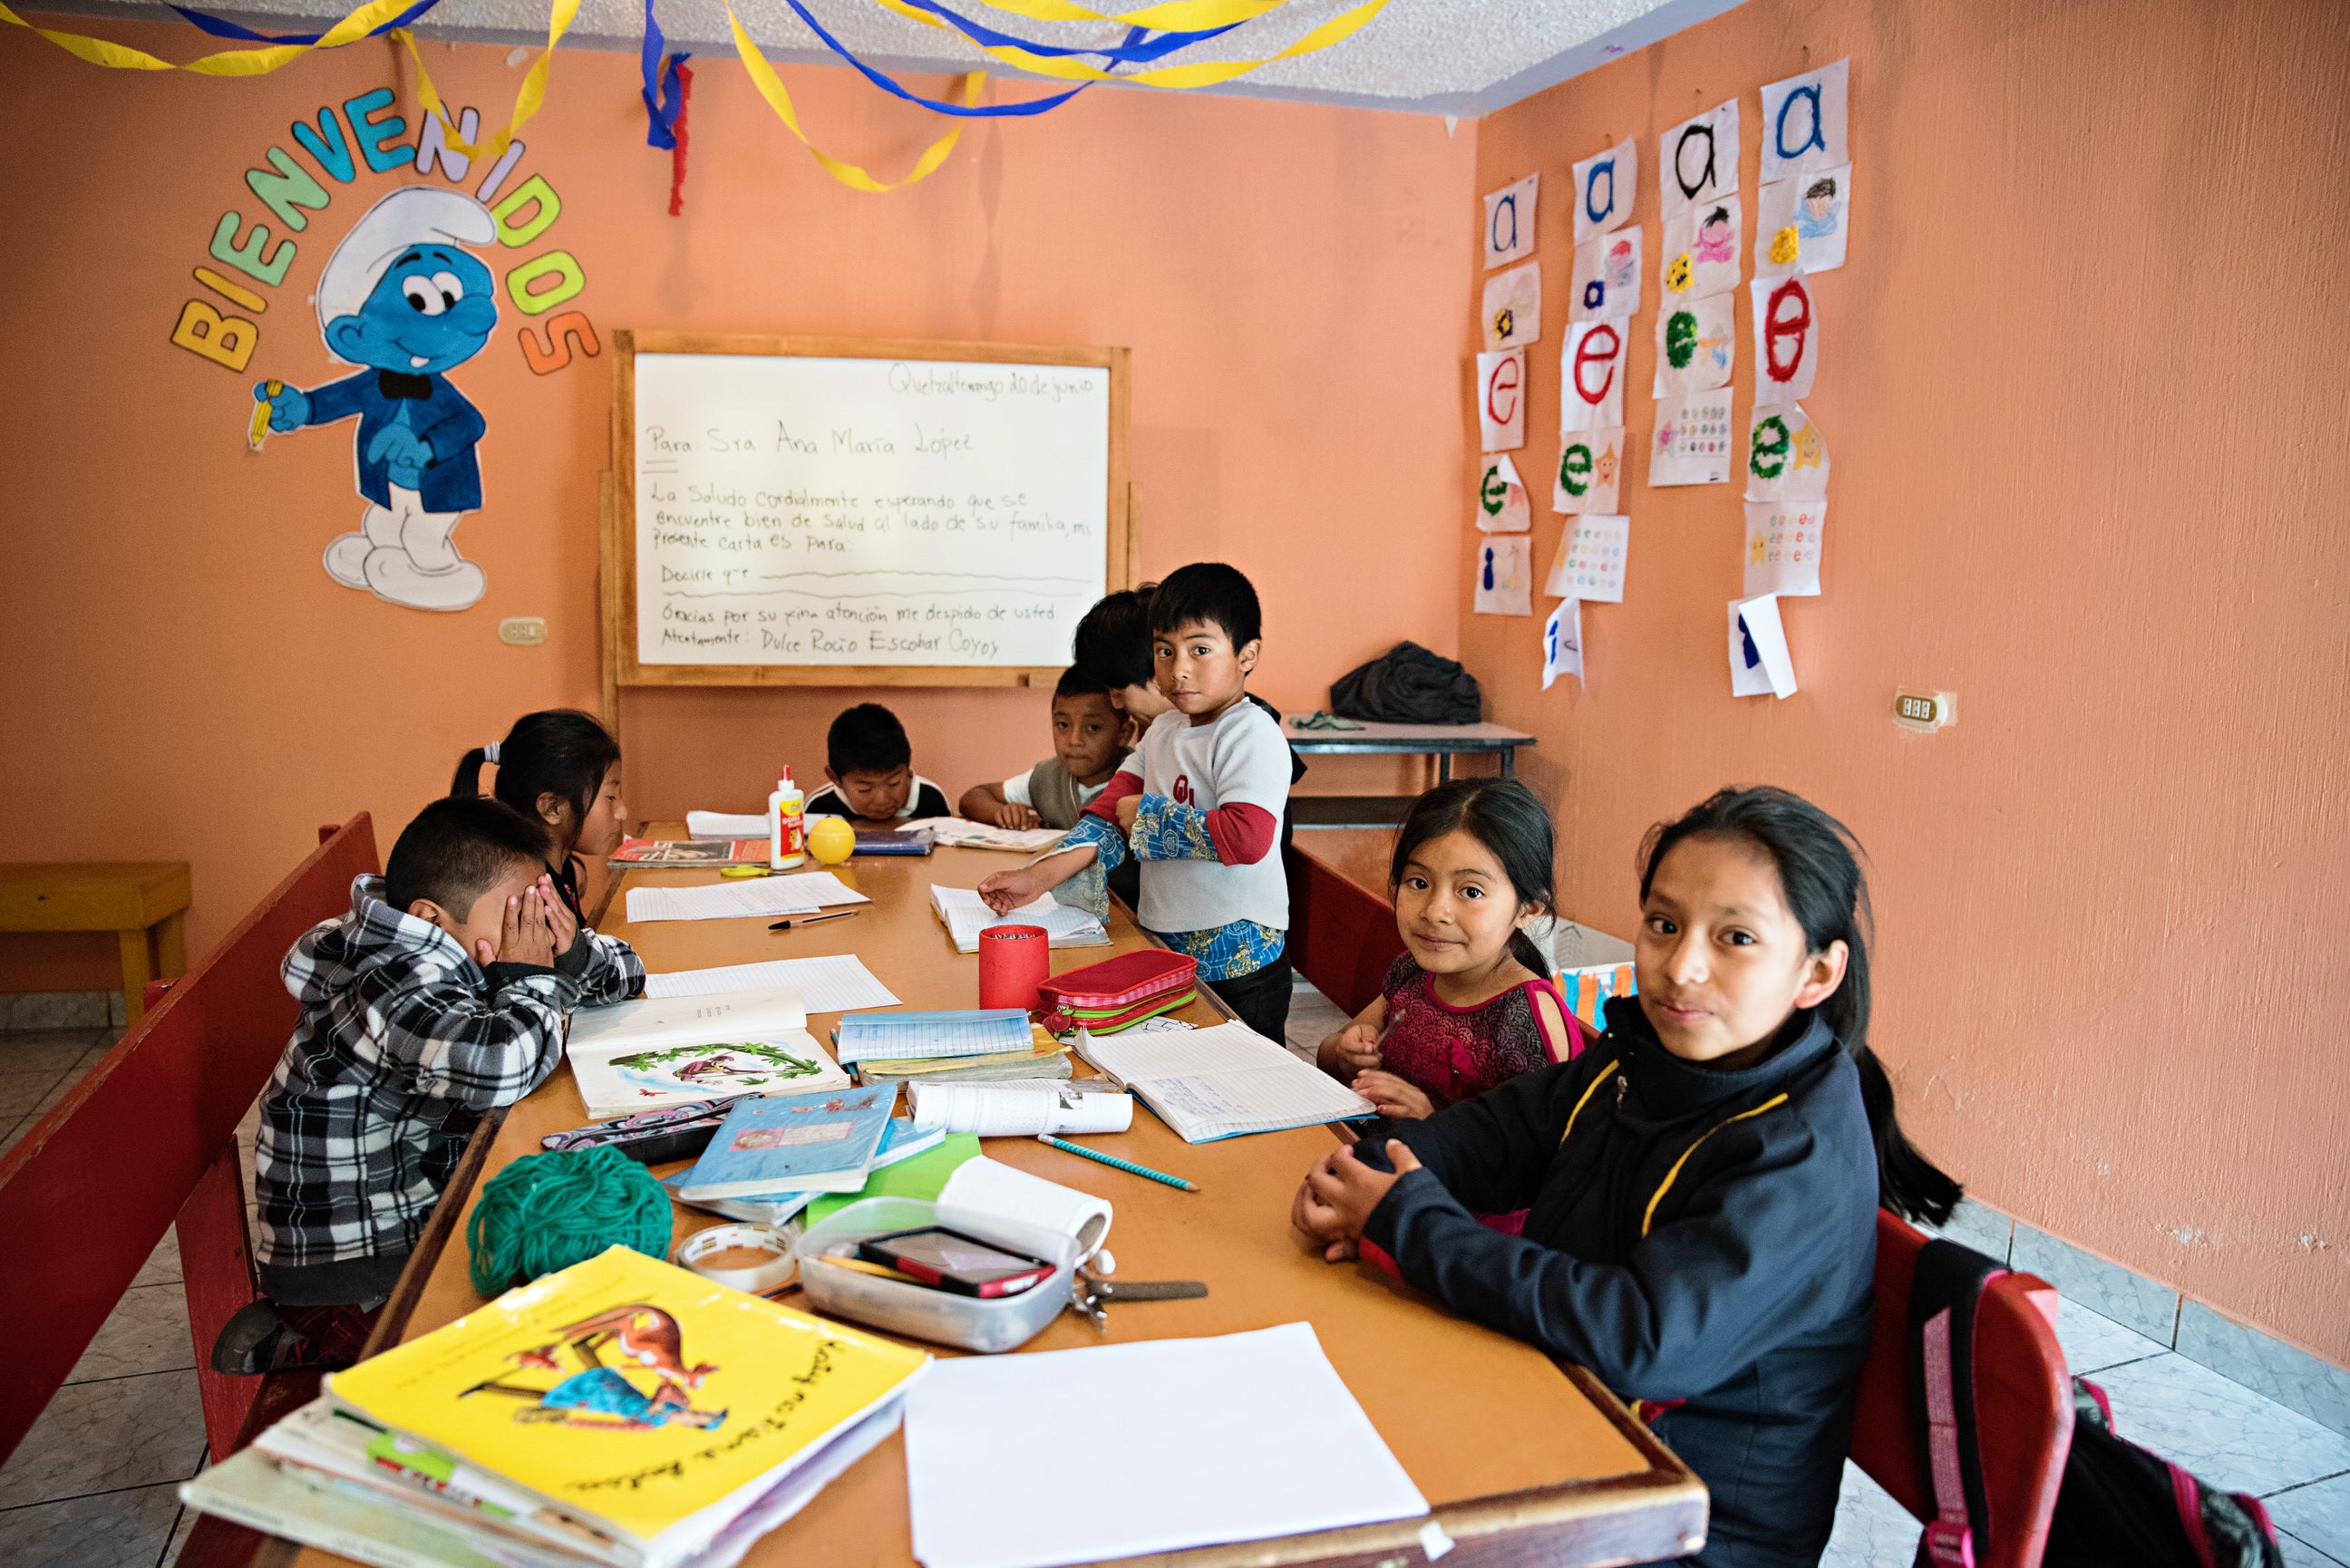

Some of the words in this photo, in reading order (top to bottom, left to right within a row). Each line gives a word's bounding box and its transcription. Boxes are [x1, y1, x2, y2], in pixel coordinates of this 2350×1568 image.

[1777, 82, 1826, 160] a
[1675, 123, 1716, 199] a
[1587, 158, 1616, 223] a
[170, 87, 600, 375] BIENVENIDOS
[1492, 195, 1518, 252] a
[1765, 277, 1811, 382] e
[1030, 373, 1047, 395] de
[1051, 375, 1093, 403] junio
[1488, 357, 1519, 425] e
[1574, 324, 1620, 404] e
[776, 418, 820, 454] Ana
[914, 421, 974, 460] López
[1750, 414, 1790, 479] e
[1481, 465, 1508, 516] e
[1559, 443, 1593, 497] e
[651, 480, 676, 502] La
[874, 494, 956, 515] esperando
[967, 495, 995, 518] que
[1003, 491, 1028, 508] se
[655, 509, 732, 529] encuentre
[743, 510, 782, 529] bien
[791, 511, 811, 530] de
[874, 516, 890, 533] al
[903, 511, 939, 532] lado
[946, 515, 966, 532] de
[976, 515, 1000, 532] su
[770, 533, 792, 550] es
[723, 567, 750, 586] que
[661, 601, 715, 624] Gracias
[723, 608, 750, 626] por
[758, 609, 778, 624] su
[896, 606, 920, 623] me
[925, 603, 982, 627] despido
[986, 604, 1006, 622] de
[761, 627, 801, 653] Dulce
[811, 627, 859, 653] Rocío
[869, 629, 941, 653] Escobar
[949, 627, 1000, 660] Coyoy
